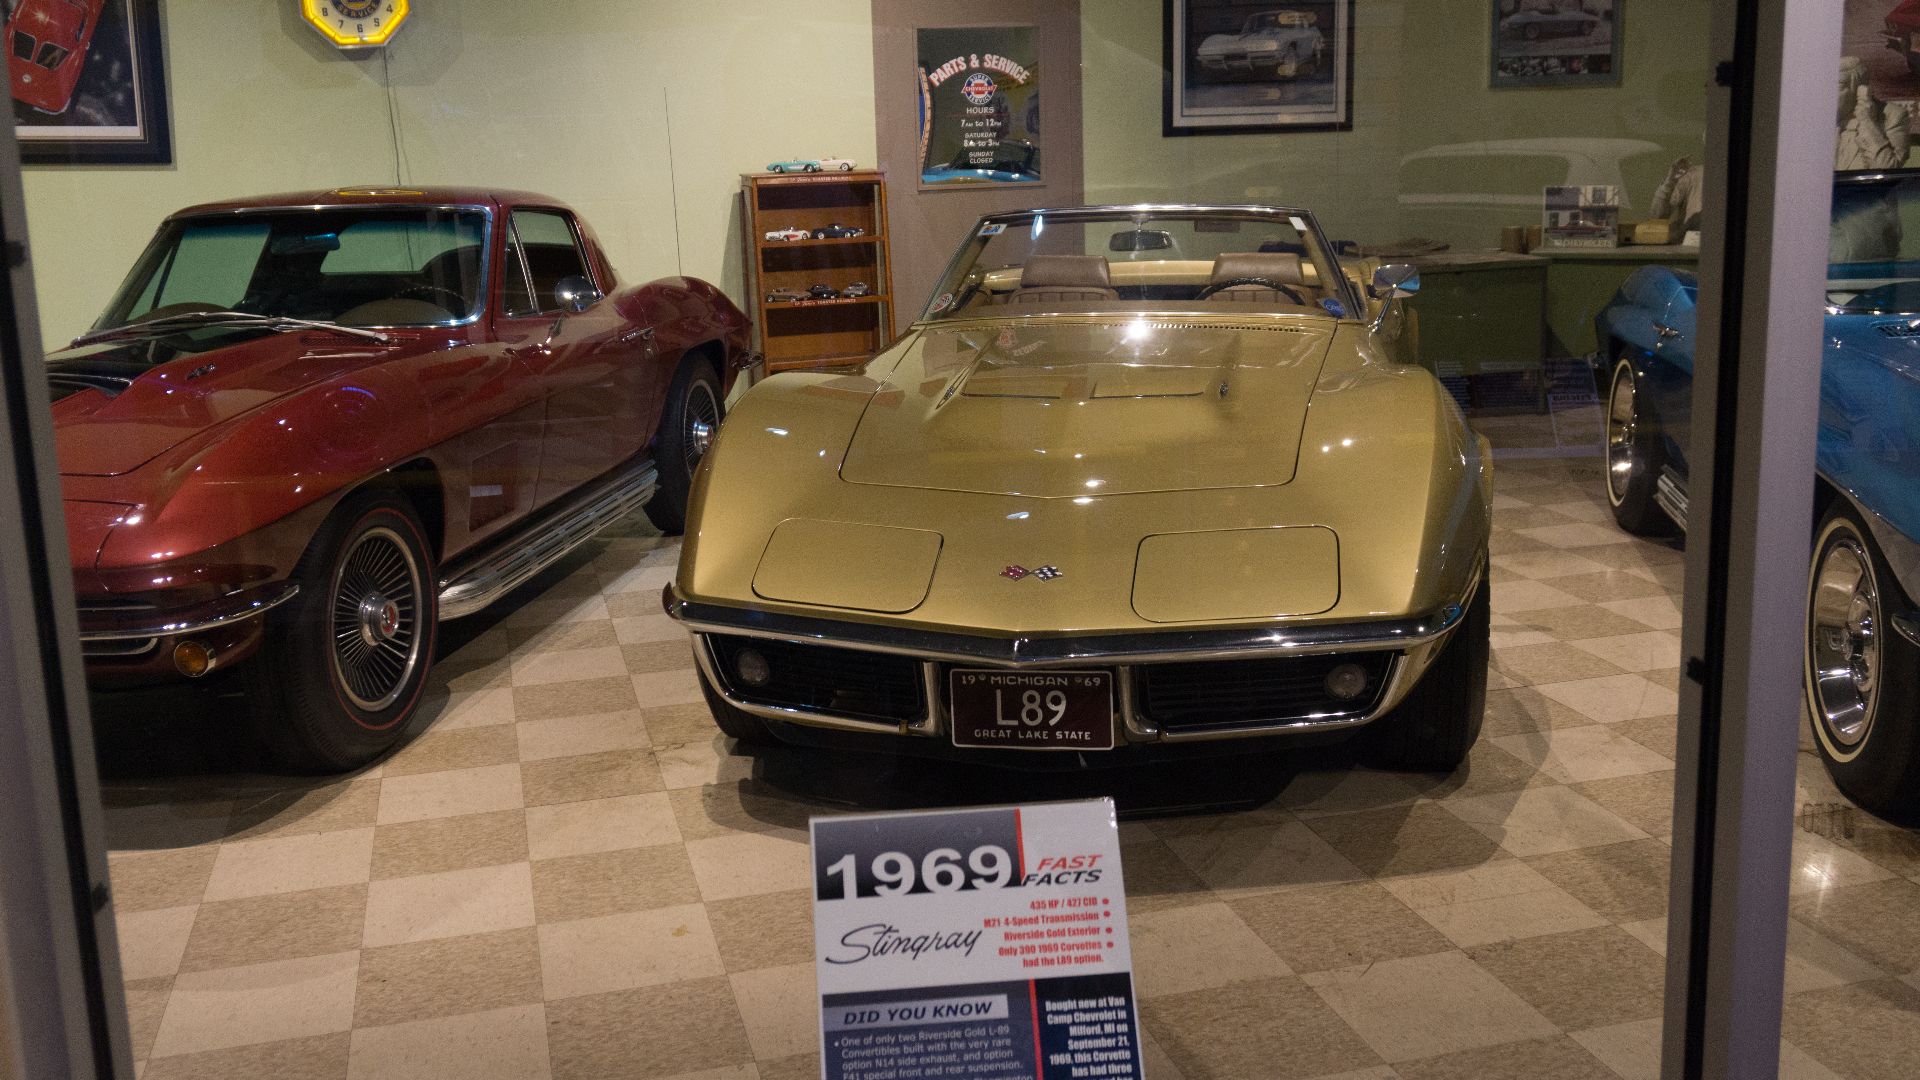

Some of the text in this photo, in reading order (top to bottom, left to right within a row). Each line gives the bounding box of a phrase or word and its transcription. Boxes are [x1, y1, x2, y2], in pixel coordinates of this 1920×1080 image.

[322, 8, 328, 16] 8
[386, 4, 392, 13] 4
[338, 20, 344, 29] 7
[357, 24, 363, 32] 6
[374, 18, 380, 26] 5
[928, 53, 1030, 87] PARTS & SERVICE
[966, 106, 994, 114] HOURS
[962, 675, 1101, 686] 19 MICHIGAN 69
[996, 689, 1067, 726] L89
[974, 729, 1091, 740] GREAT LAKE STATE
[1037, 854, 1103, 871] FAST
[827, 845, 1012, 899] 1969
[1023, 869, 1102, 886] FACTS
[1030, 901, 1046, 910] 435
[1049, 900, 1058, 909] HP
[1067, 898, 1081, 907] 427
[1083, 896, 1097, 906] CID
[984, 912, 1099, 928] M21 4-Speed Transmission
[1004, 926, 1100, 941] Riverside Gold Exterior
[825, 923, 983, 964] Stingray
[999, 941, 1102, 956] Only 390 1969 Corvettes
[1023, 954, 1104, 968] had the L89 option.
[1045, 997, 1125, 1011] Bought new at Van
[844, 1001, 993, 1025] DID YOU KNOW
[1047, 1009, 1126, 1025] Camp Chevrolet in
[841, 1025, 1010, 1047] One of only two Riverside Gold L-89
[1069, 1023, 1128, 1036] Milford, MI on
[842, 1039, 1011, 1058] Convertibles built with the very rare
[1068, 1037, 1116, 1050] September
[842, 1060, 872, 1072] option
[875, 1058, 895, 1068] N14
[898, 1056, 917, 1066] side
[963, 1051, 980, 1060] and
[984, 1049, 1013, 1060] option
[1049, 1050, 1131, 1065] 1969, this Corvette
[864, 1068, 896, 1080] special
[899, 1067, 921, 1077] front
[925, 1066, 943, 1076] and
[946, 1065, 965, 1073] rear
[968, 1060, 1023, 1073] suspension.
[1072, 1063, 1132, 1077] has had three
